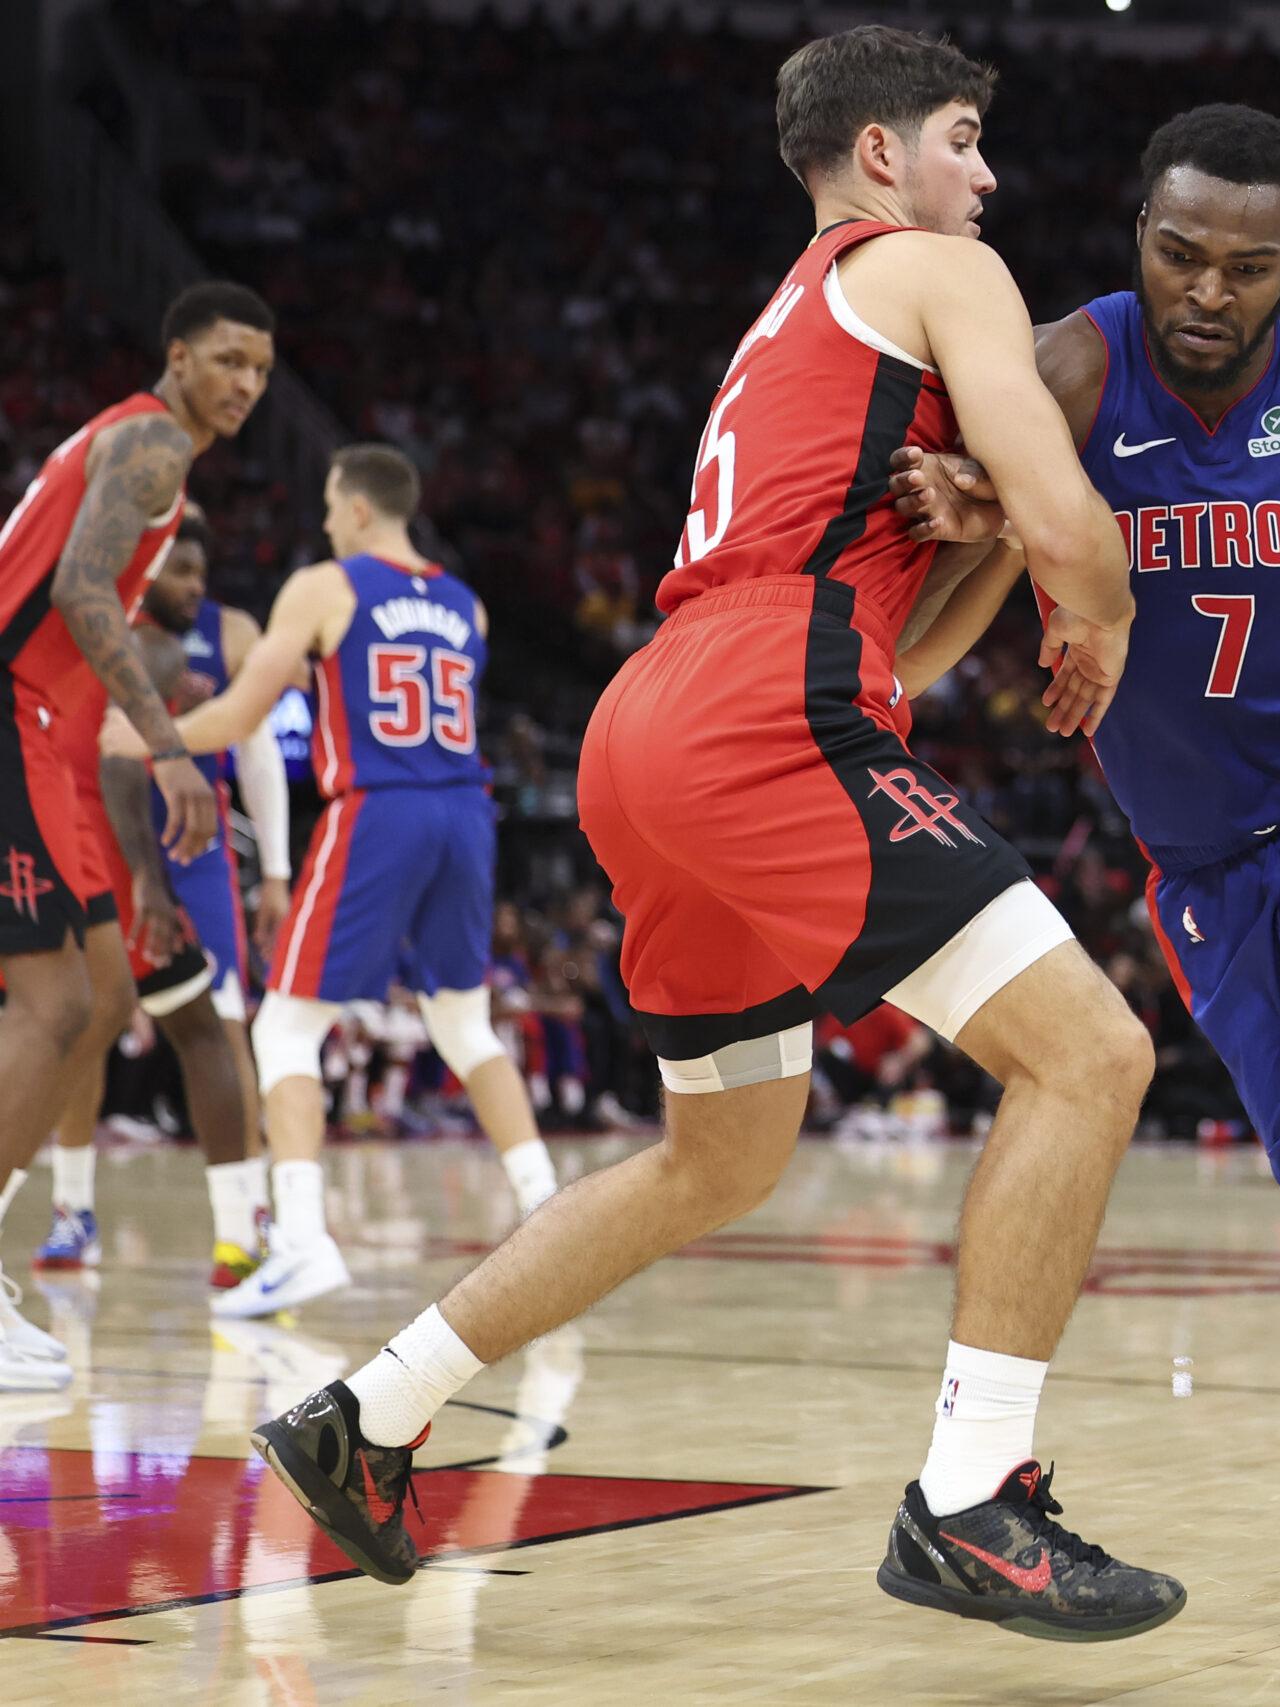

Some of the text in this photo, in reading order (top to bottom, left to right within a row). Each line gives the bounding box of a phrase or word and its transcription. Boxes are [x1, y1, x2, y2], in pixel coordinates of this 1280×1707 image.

[674, 373, 748, 569] 5
[367, 642, 476, 755] 55
[1191, 594, 1255, 698] 7
